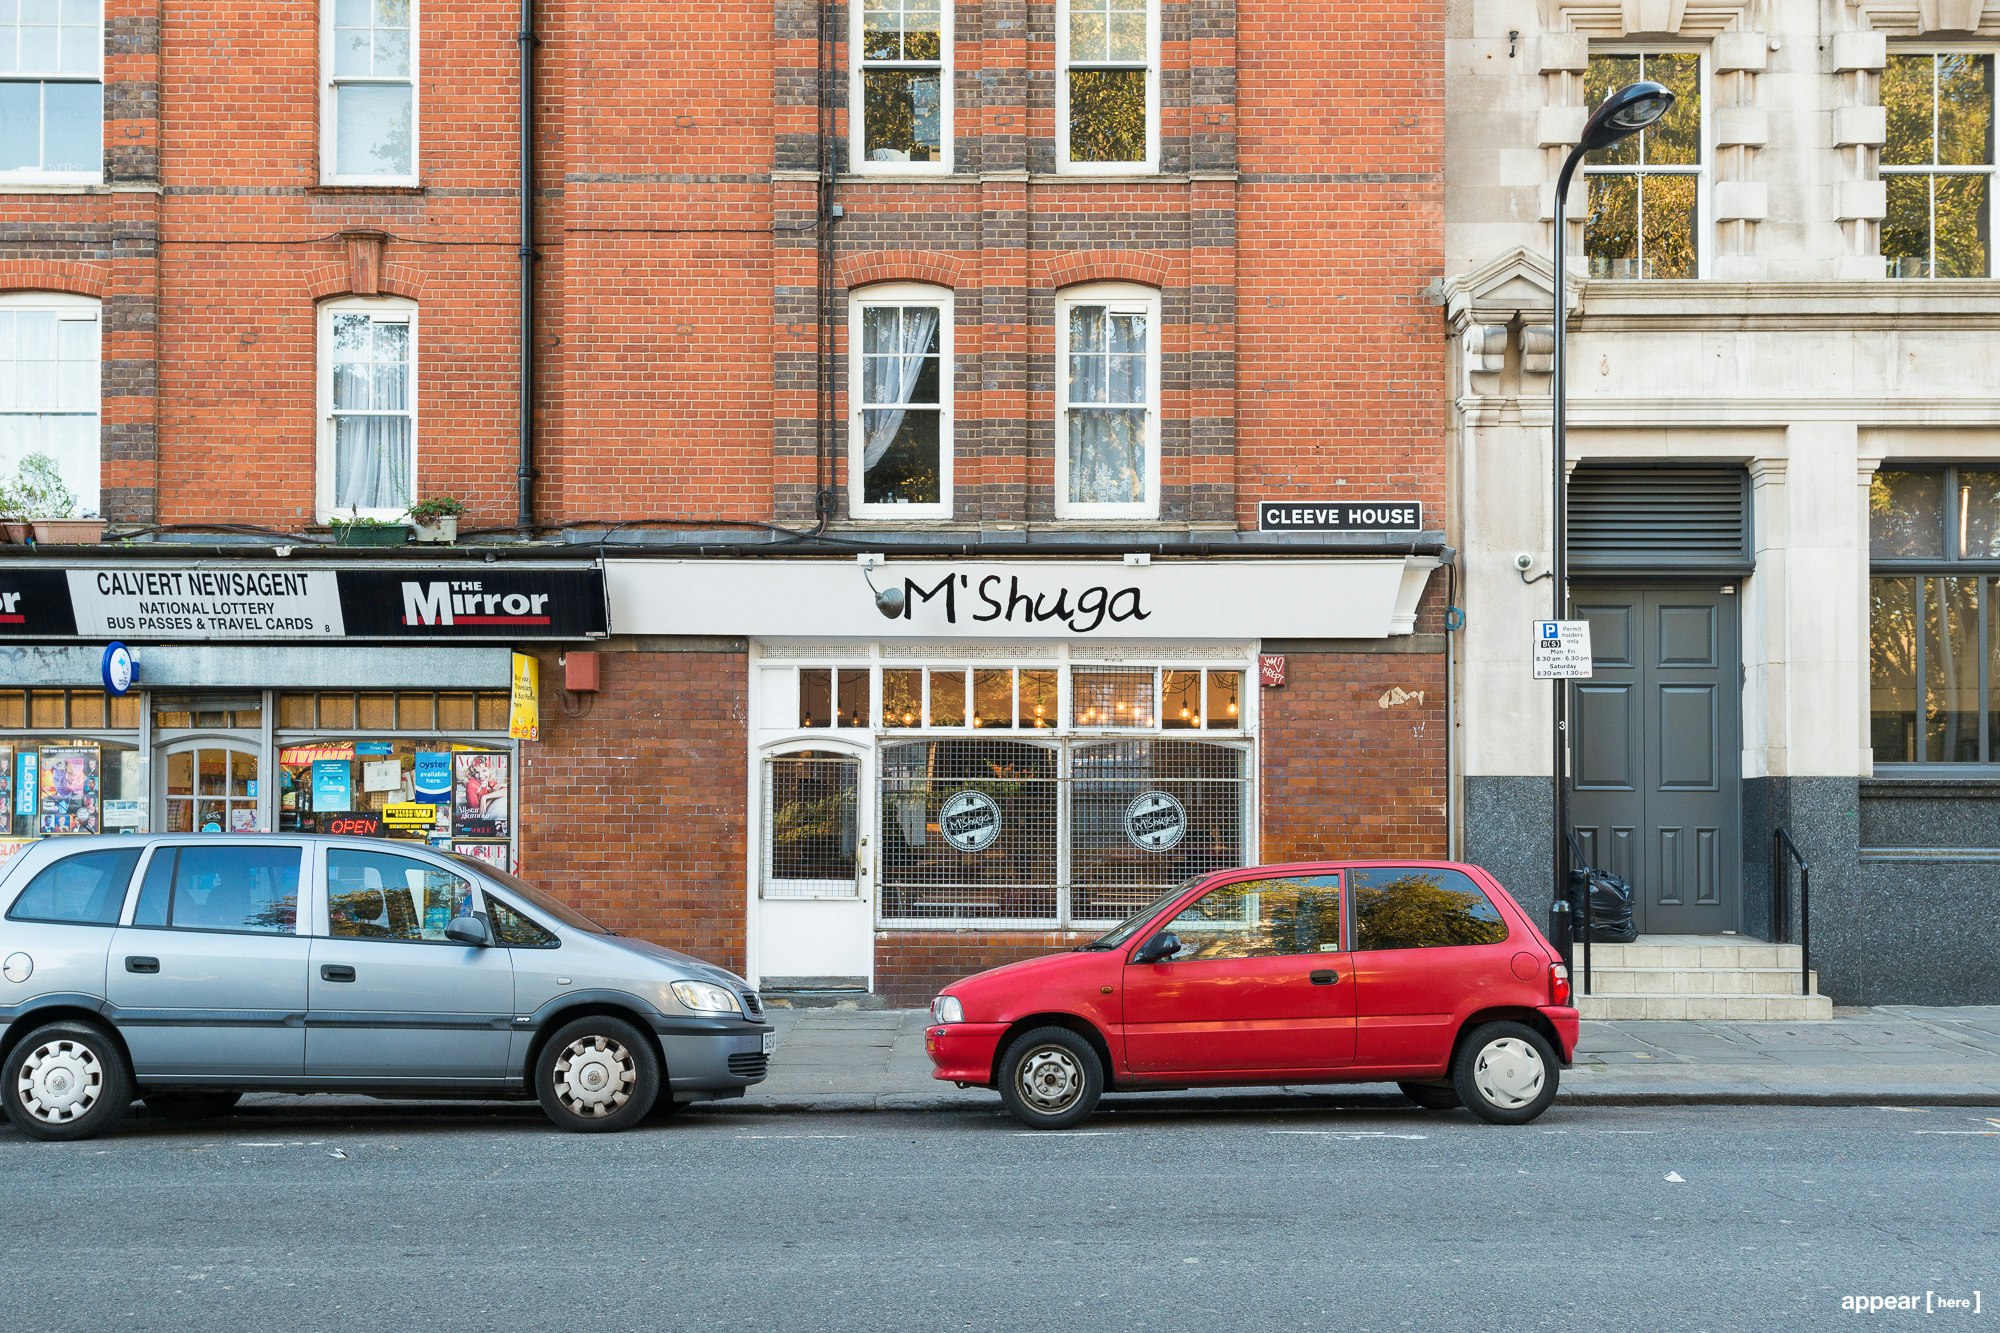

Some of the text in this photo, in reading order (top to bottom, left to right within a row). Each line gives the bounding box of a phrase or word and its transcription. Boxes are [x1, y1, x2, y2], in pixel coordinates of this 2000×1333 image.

[1266, 509, 1415, 525] CLEEVE HOUSE
[96, 572, 309, 597] CALVERT NEWSAGENT
[451, 581, 483, 592] THE
[0, 591, 21, 613] r
[139, 602, 275, 615] NATIONAL LOTTERY
[401, 581, 549, 626] Mirror
[904, 572, 1152, 633] M'Shuga
[106, 616, 314, 630] BUS PASSES & TRAVEL CARDS
[1545, 624, 1556, 638] P
[1558, 720, 1566, 731] 3
[280, 750, 354, 764] NEWSAGENT
[457, 755, 508, 769] VOGUE
[419, 761, 448, 770] oyster
[24, 767, 36, 813] Lebara
[331, 820, 378, 834] OPEN
[950, 814, 993, 831] M'Shuga
[1135, 814, 1178, 831] M'Shuga
